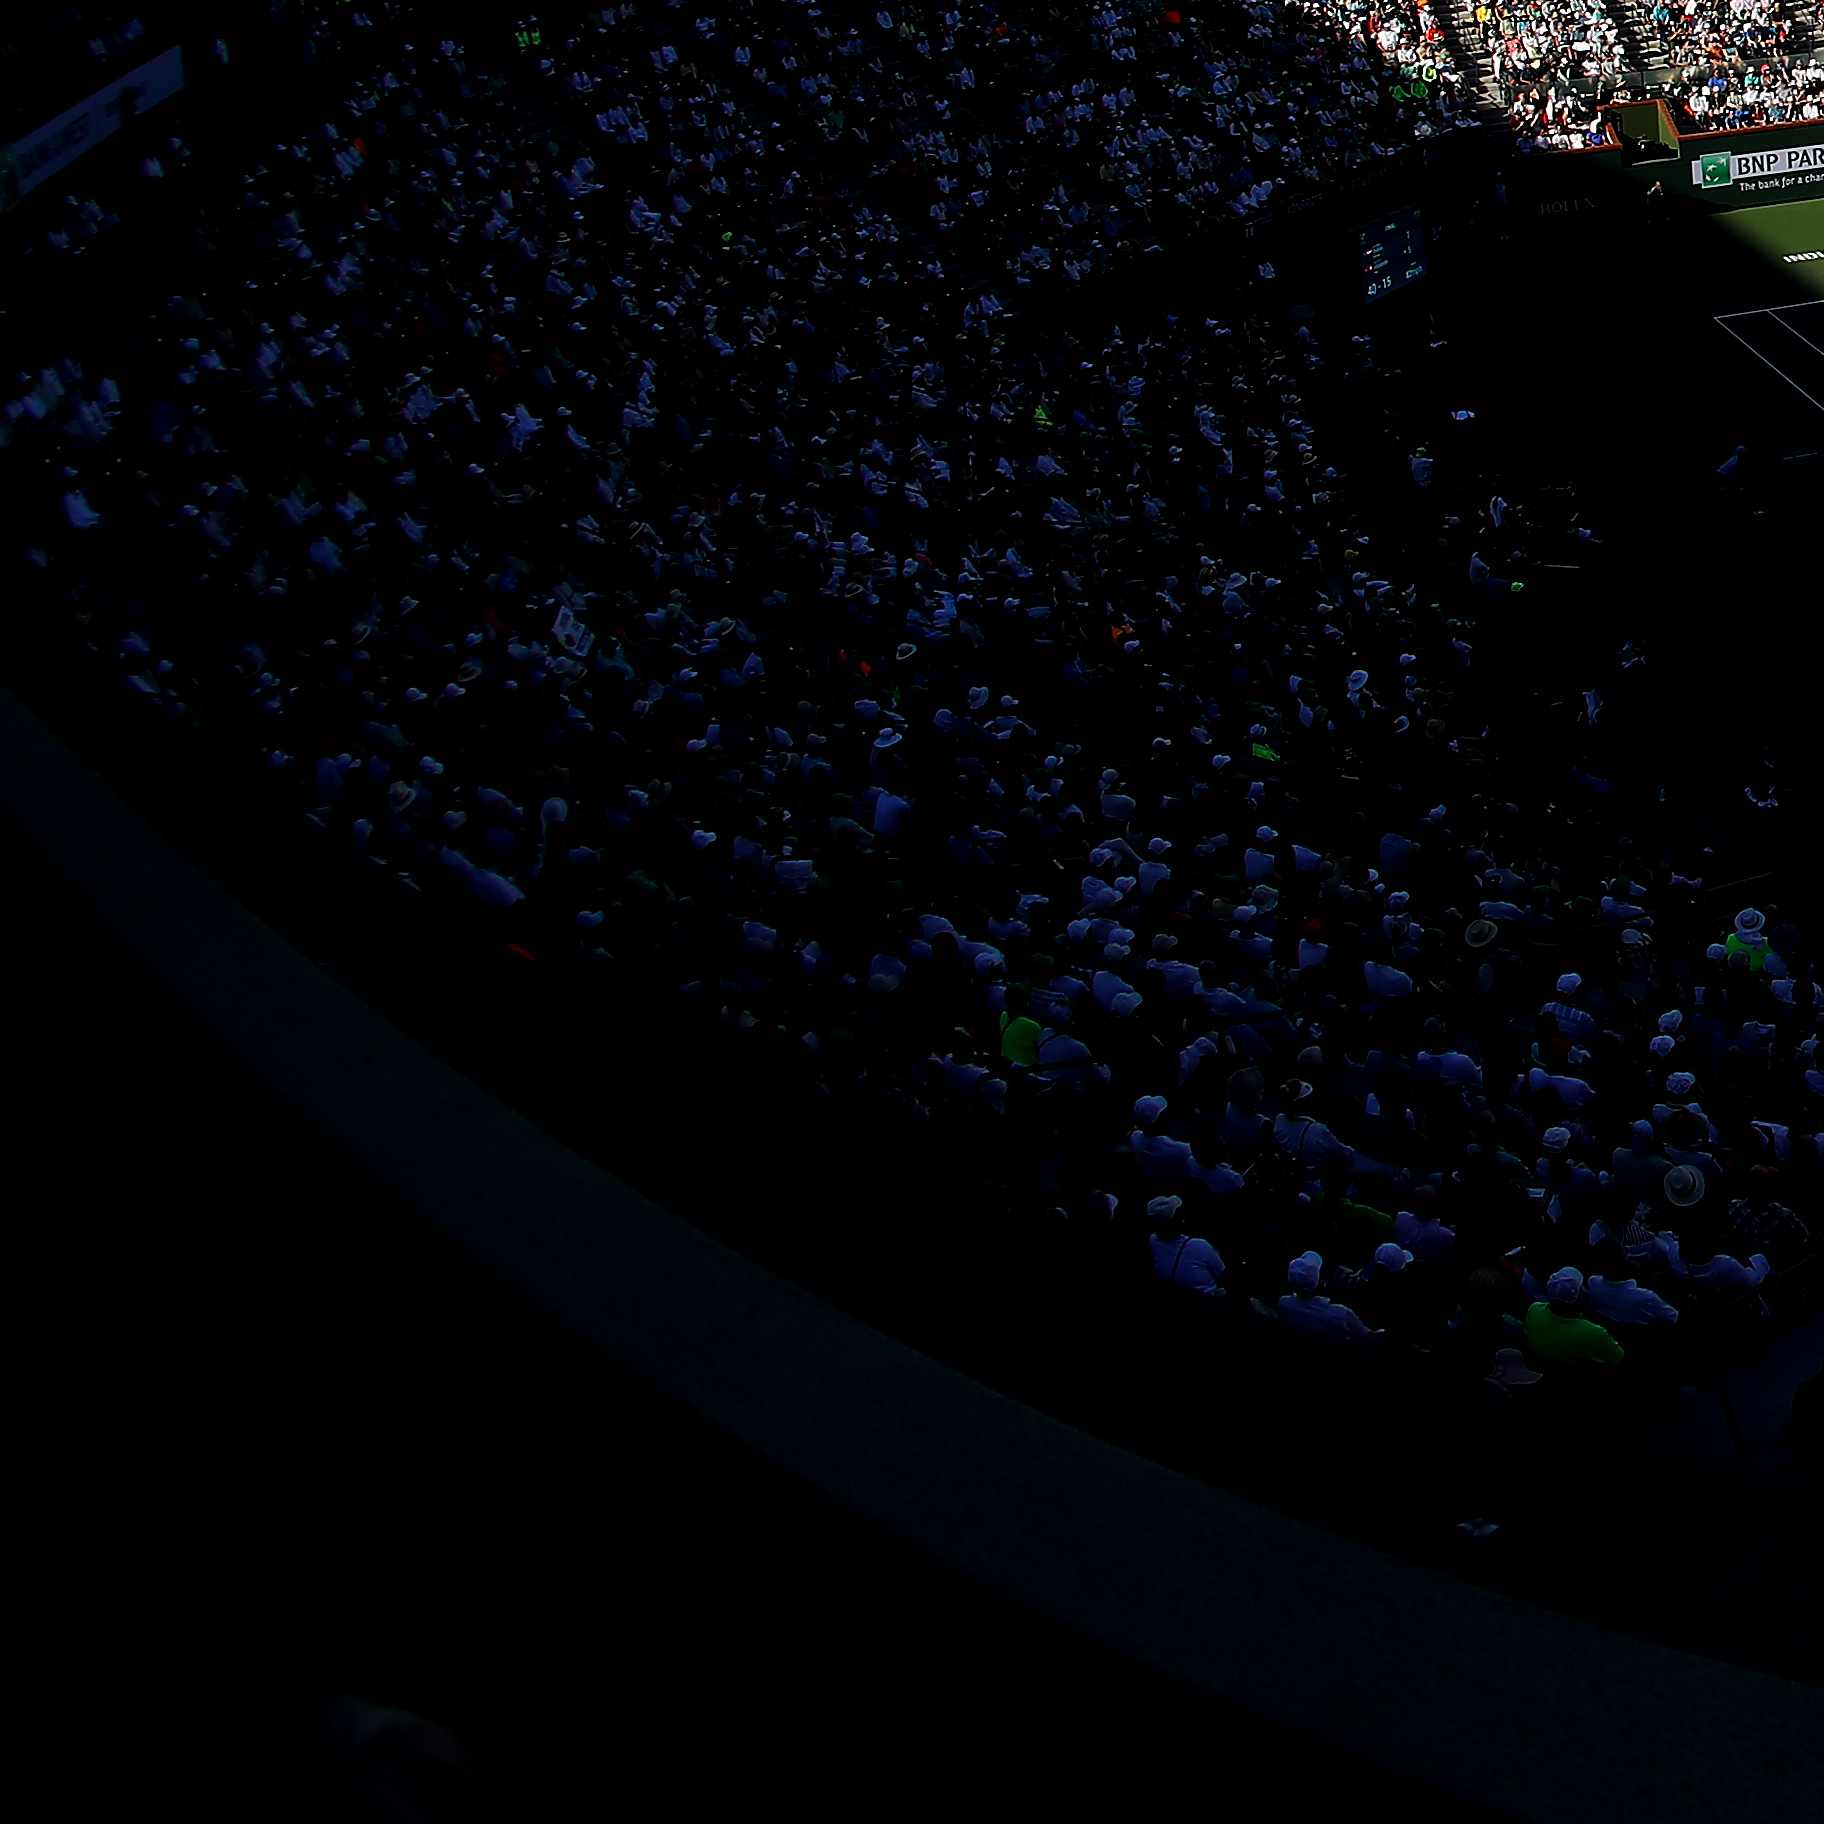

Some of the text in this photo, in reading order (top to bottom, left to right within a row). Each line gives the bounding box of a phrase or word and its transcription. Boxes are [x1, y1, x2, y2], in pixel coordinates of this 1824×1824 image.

[1737, 154, 1779, 176] BNP
[1739, 182, 1756, 192] The
[1758, 177, 1781, 190] bank
[1781, 176, 1795, 189] for
